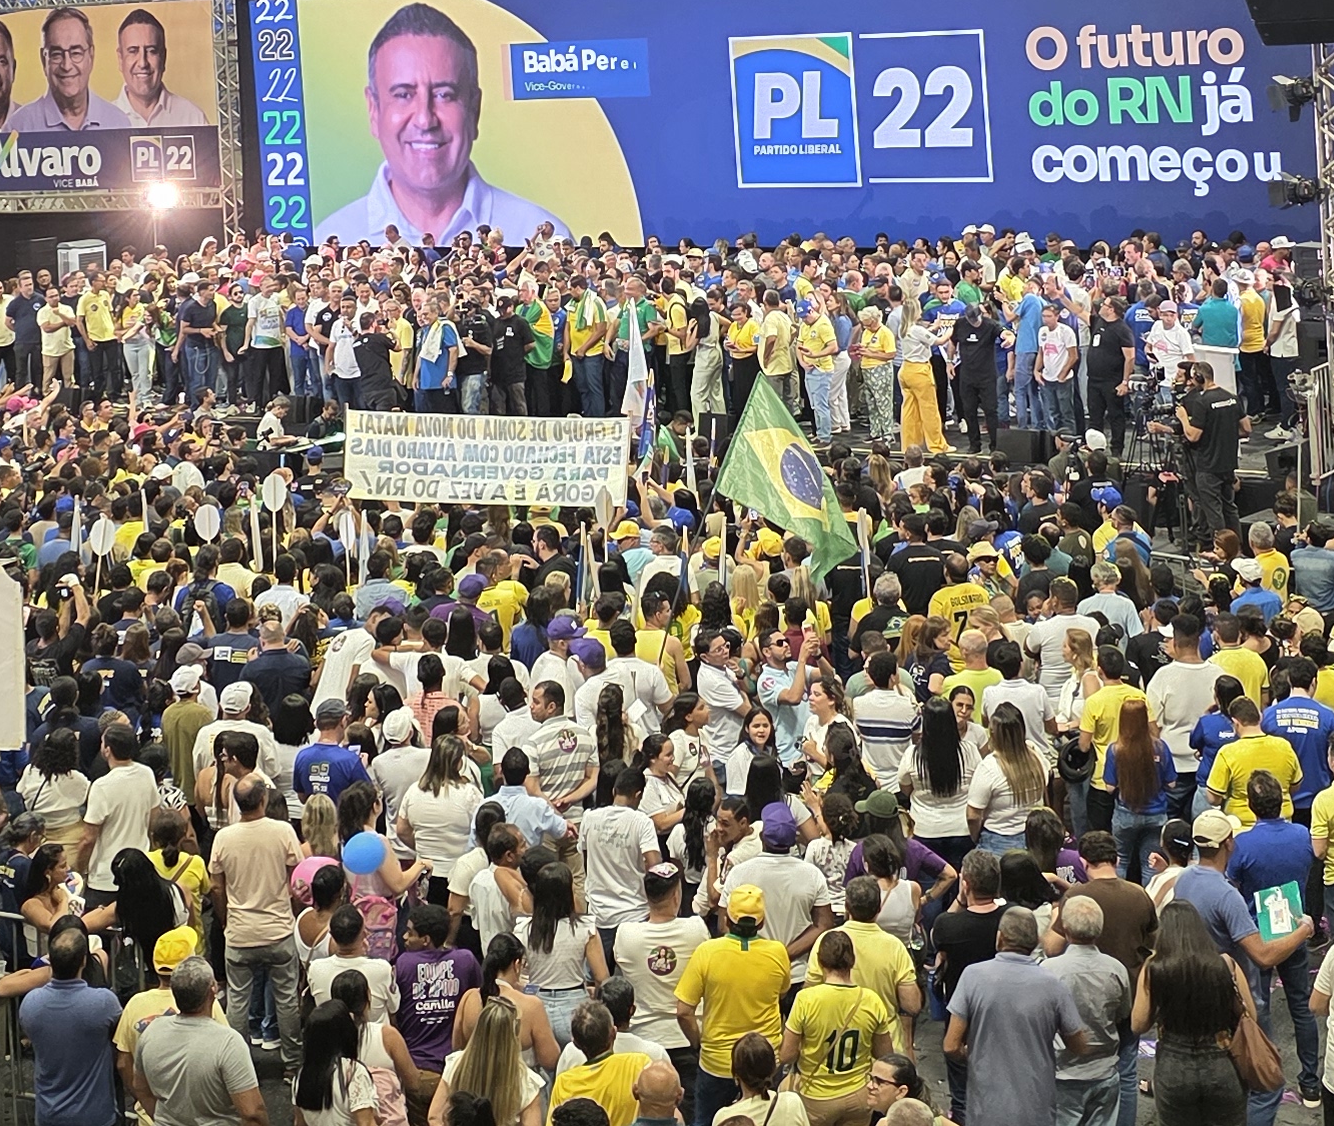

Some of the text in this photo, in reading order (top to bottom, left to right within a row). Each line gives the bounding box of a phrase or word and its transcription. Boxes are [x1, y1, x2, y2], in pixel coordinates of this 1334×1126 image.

[258, 28, 295, 62] 22
[523, 45, 579, 74] Babá
[1025, 24, 1245, 71] O futuro
[262, 67, 299, 103] 22
[1028, 66, 1254, 136] do RN já
[753, 70, 839, 140] PL
[873, 64, 973, 149] 22
[263, 110, 302, 145] 22
[135, 145, 159, 168] PL
[166, 144, 192, 170] 22
[753, 143, 842, 156] PARTIDO LIBERAL
[53, 175, 100, 188] VICE BABÁ
[266, 152, 305, 186] 22
[1031, 144, 1283, 197] começou
[268, 195, 308, 229] 22
[412, 980, 427, 1000] DE
[415, 998, 455, 1012] Camila
[826, 1029, 860, 1074] 10
